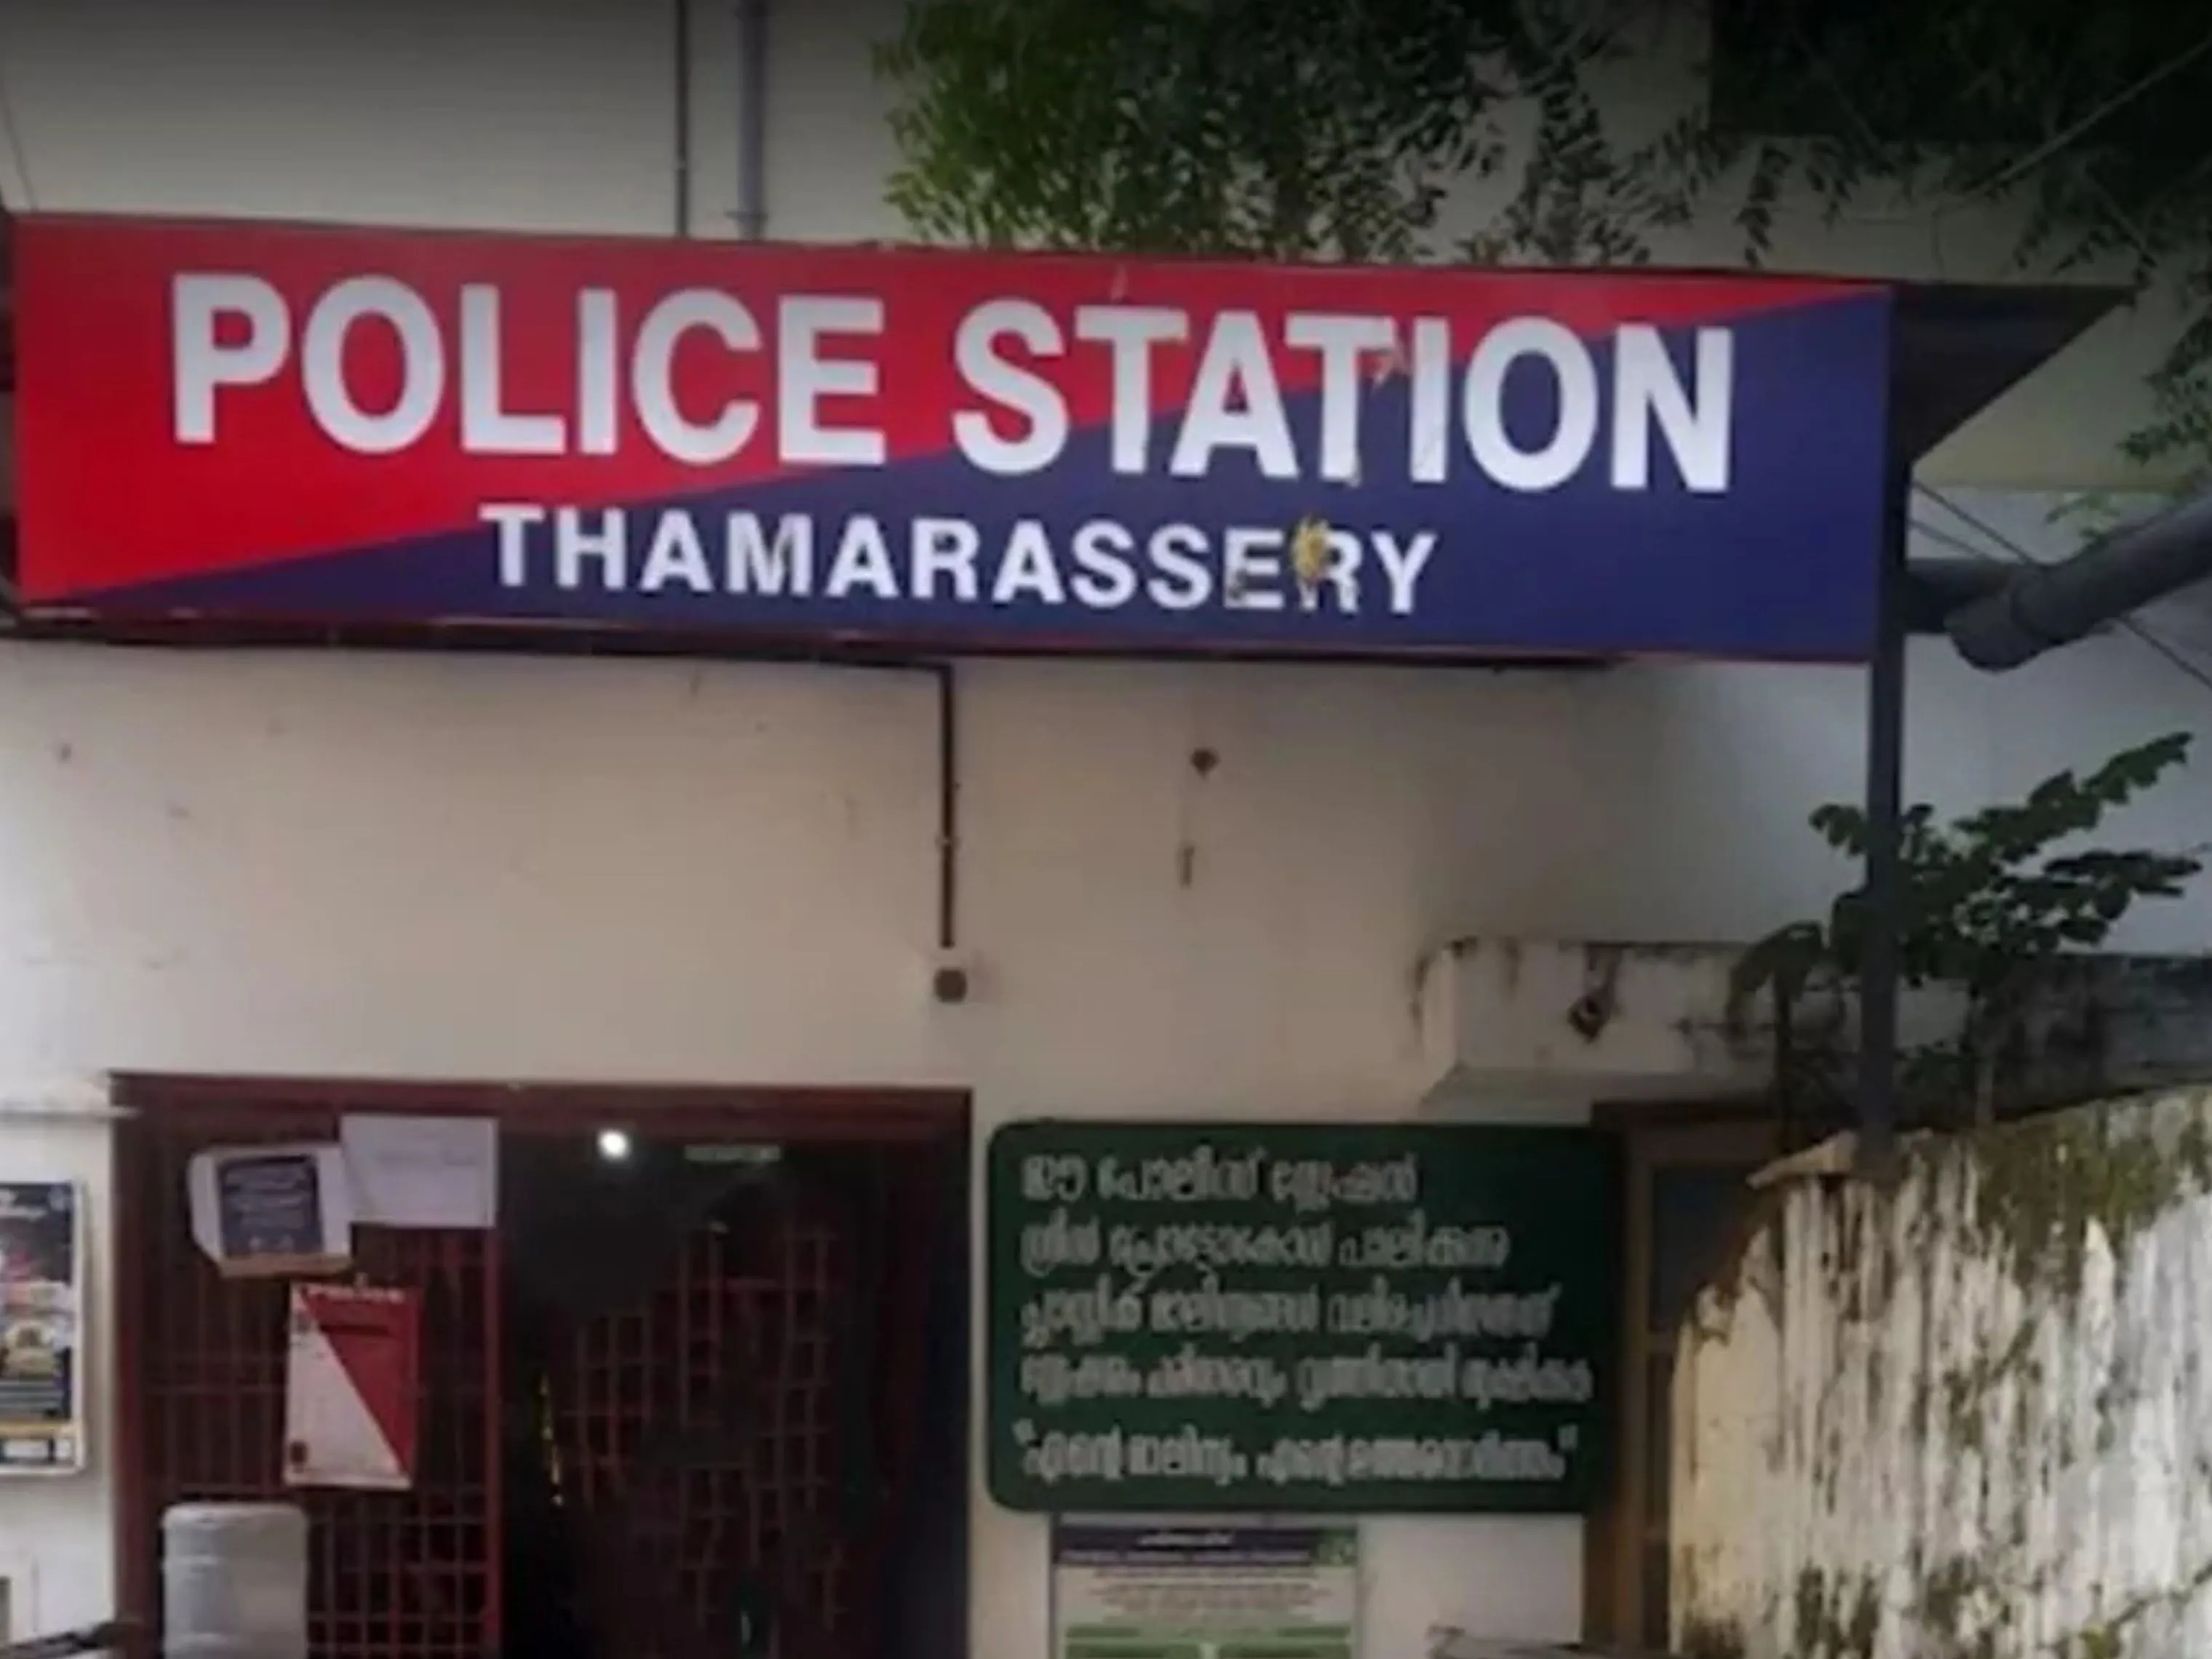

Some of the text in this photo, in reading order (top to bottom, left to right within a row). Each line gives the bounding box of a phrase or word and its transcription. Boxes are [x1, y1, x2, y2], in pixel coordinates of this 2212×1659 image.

[172, 271, 1733, 493] POLICE STATION
[480, 504, 1436, 613] THAMARASSERY
[1021, 1154, 1086, 1202] ഈ
